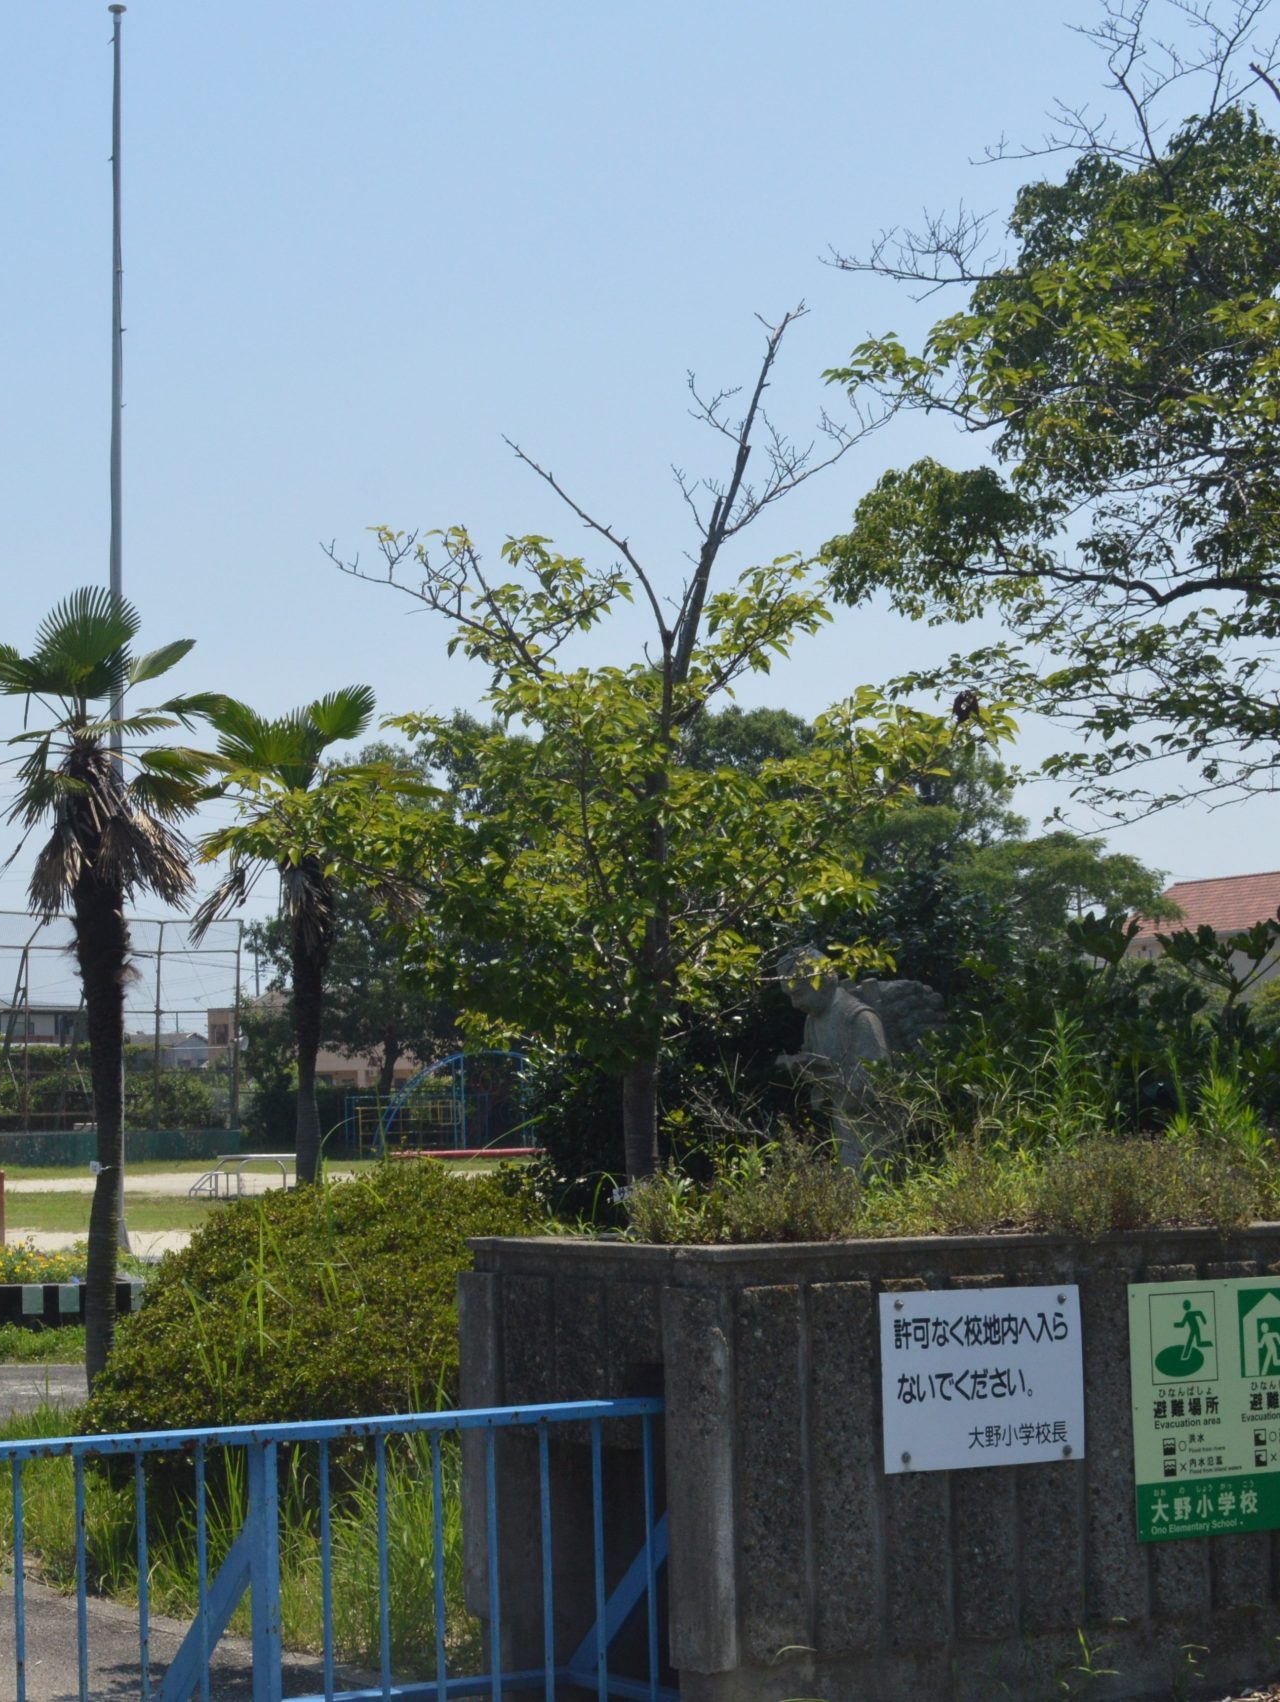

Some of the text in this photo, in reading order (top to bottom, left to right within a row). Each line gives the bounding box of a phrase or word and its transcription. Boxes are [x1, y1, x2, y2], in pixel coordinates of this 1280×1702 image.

[893, 1312, 1068, 1350] 許可なく校地内へ入ら
[897, 1367, 1033, 1405] ないでください。
[1158, 1386, 1212, 1398] ひなんばしょ
[1250, 1381, 1280, 1391] ひなん
[1153, 1396, 1219, 1419] 避難場所
[1154, 1416, 1221, 1429] Evacuation area
[968, 1421, 1068, 1449] 大野小学校長
[1150, 1489, 1258, 1524] 大野小学校
[1151, 1518, 1238, 1535] Ono Elementary School
